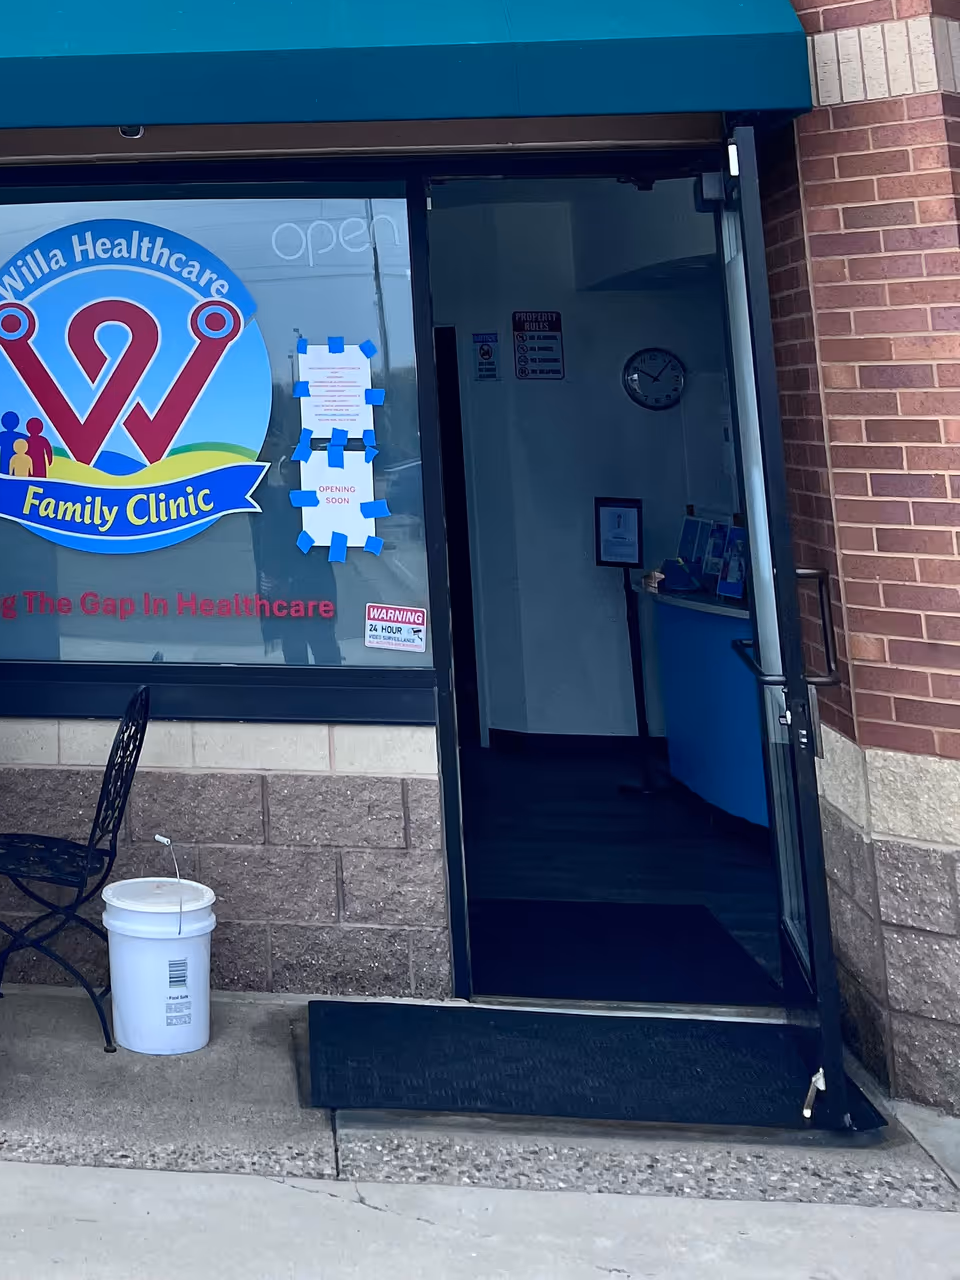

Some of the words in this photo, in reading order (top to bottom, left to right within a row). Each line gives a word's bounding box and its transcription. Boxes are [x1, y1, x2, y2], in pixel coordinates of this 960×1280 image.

[272, 214, 400, 267] open
[71, 230, 230, 300] Healthcare
[515, 312, 557, 322] PROPERTY
[318, 485, 356, 493] OPENING
[22, 485, 118, 532] Family
[126, 485, 214, 525] Clinic
[22, 590, 73, 615] The
[79, 591, 137, 623] Gap
[142, 591, 170, 616] In
[176, 591, 336, 619] Healthcare
[369, 607, 424, 624] WARNING
[368, 623, 378, 632] 24
[381, 625, 403, 635] HOUR
